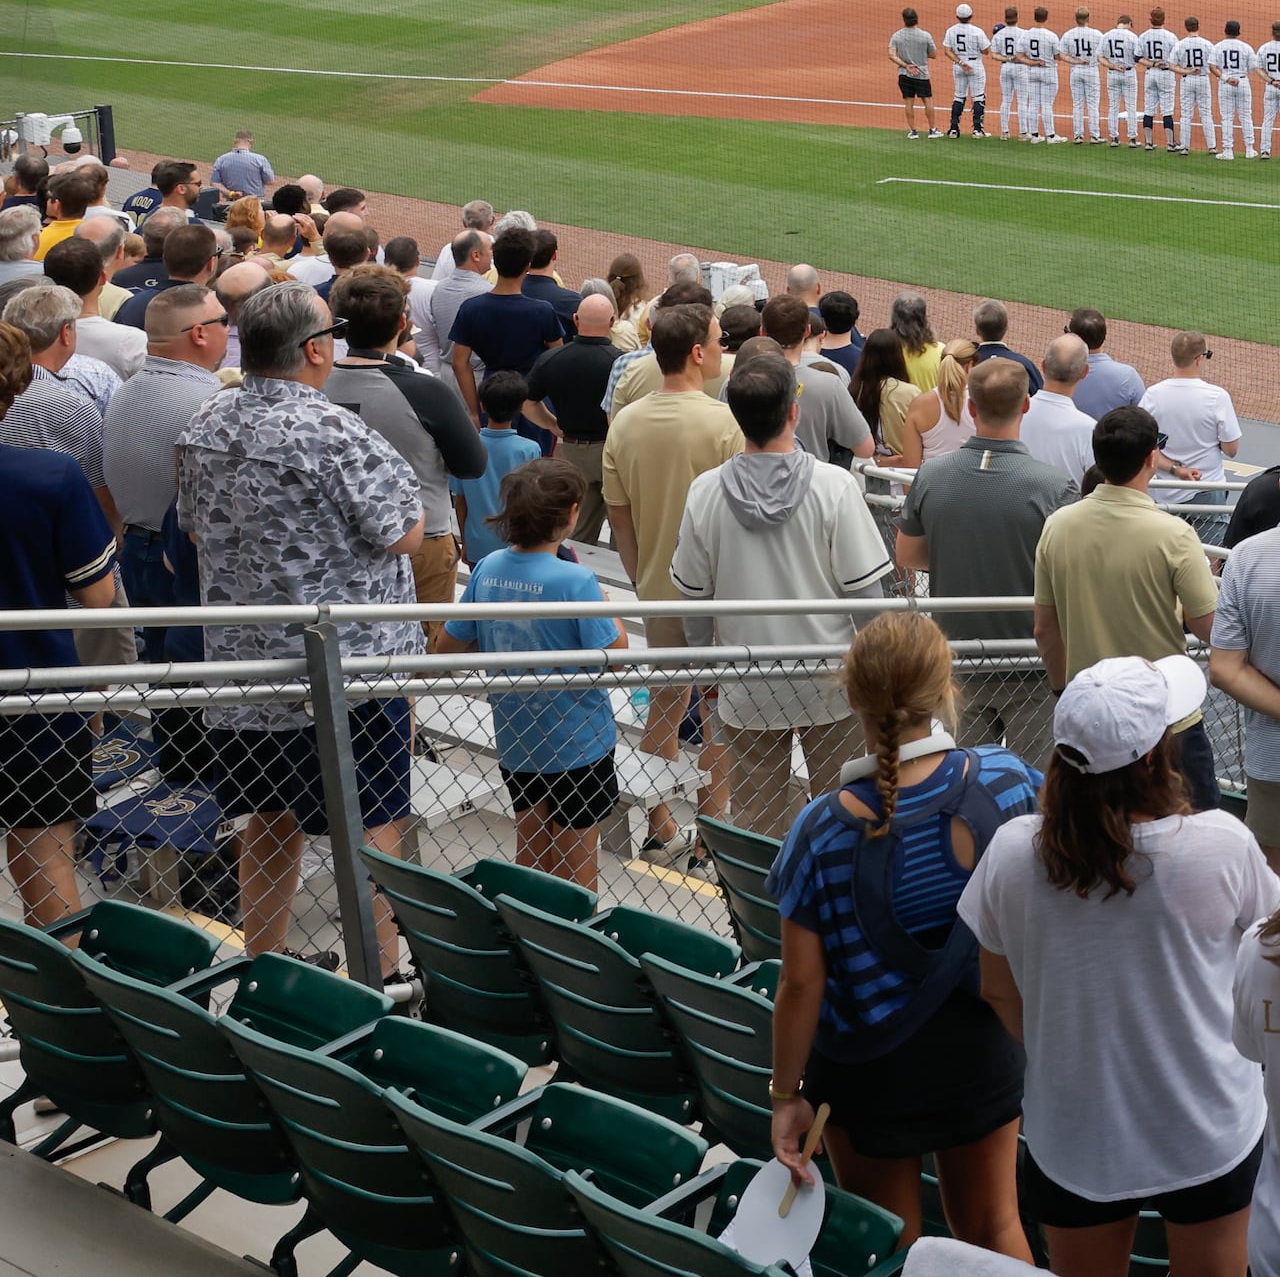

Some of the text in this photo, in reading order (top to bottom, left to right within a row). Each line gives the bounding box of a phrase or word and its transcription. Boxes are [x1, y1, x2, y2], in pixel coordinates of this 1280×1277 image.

[956, 34, 966, 52] 5
[1004, 38, 1014, 55] 6
[1030, 40, 1040, 57] 9
[1074, 38, 1092, 56] 14
[1108, 39, 1124, 58] 15
[1147, 41, 1163, 60] 16
[1186, 49, 1203, 67] 18
[1223, 50, 1240, 69] 19
[131, 195, 154, 210] WOOD
